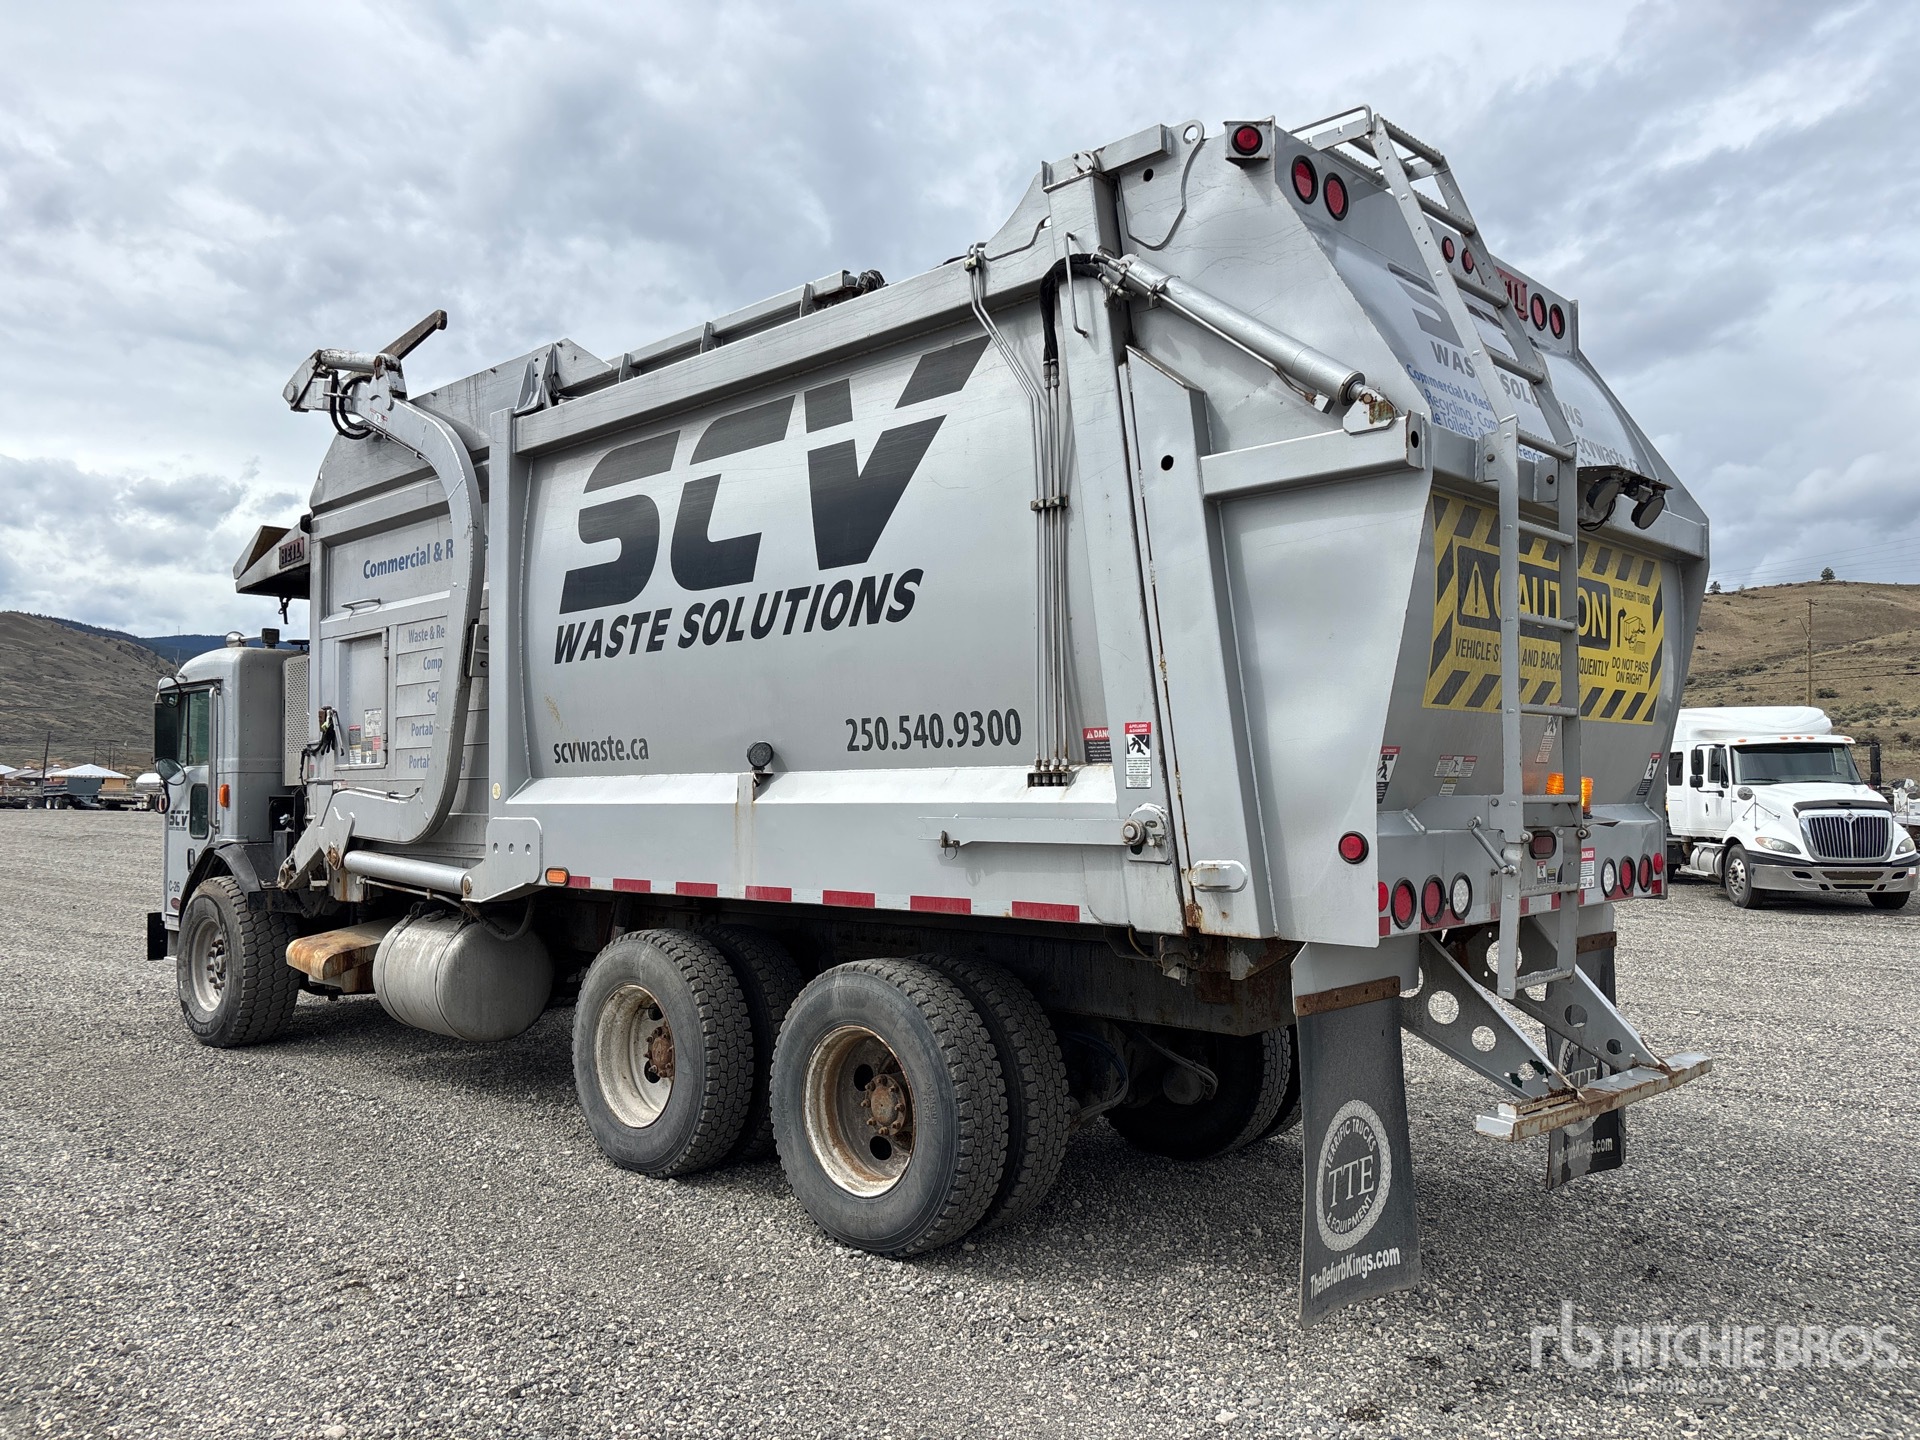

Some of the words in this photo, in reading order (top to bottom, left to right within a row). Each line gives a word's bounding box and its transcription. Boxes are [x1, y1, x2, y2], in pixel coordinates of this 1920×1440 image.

[1430, 341, 1476, 378] WAS
[1424, 388, 1474, 425] Recycling
[559, 336, 991, 614] SCV
[363, 543, 430, 580] Commercial
[433, 541, 443, 562] &
[1613, 586, 1624, 600] WIDE
[1624, 589, 1637, 602] RIGHT
[1637, 592, 1651, 606] TURNS
[408, 629, 428, 643] Waste
[430, 625, 435, 640] &
[554, 607, 672, 665] WASTE
[677, 568, 924, 650] SOLUTIONS
[1455, 637, 1491, 662] VEHICLE
[1521, 648, 1539, 668] AND
[1612, 656, 1620, 670] DO
[1621, 658, 1634, 672] NOT
[1634, 660, 1649, 674] PASS
[1616, 671, 1625, 683] ON
[1625, 673, 1643, 686] RIGHT
[845, 708, 1022, 752] 250.540.9300
[553, 735, 650, 764] scvwaste.ca
[1325, 1120, 1351, 1169] TERRIFIC
[1352, 1118, 1377, 1152] TRUCKS
[1328, 1154, 1375, 1208] TTE
[1330, 1194, 1373, 1233] EQUIPMENT
[1310, 1246, 1401, 1300] TheRefurbKings.com
